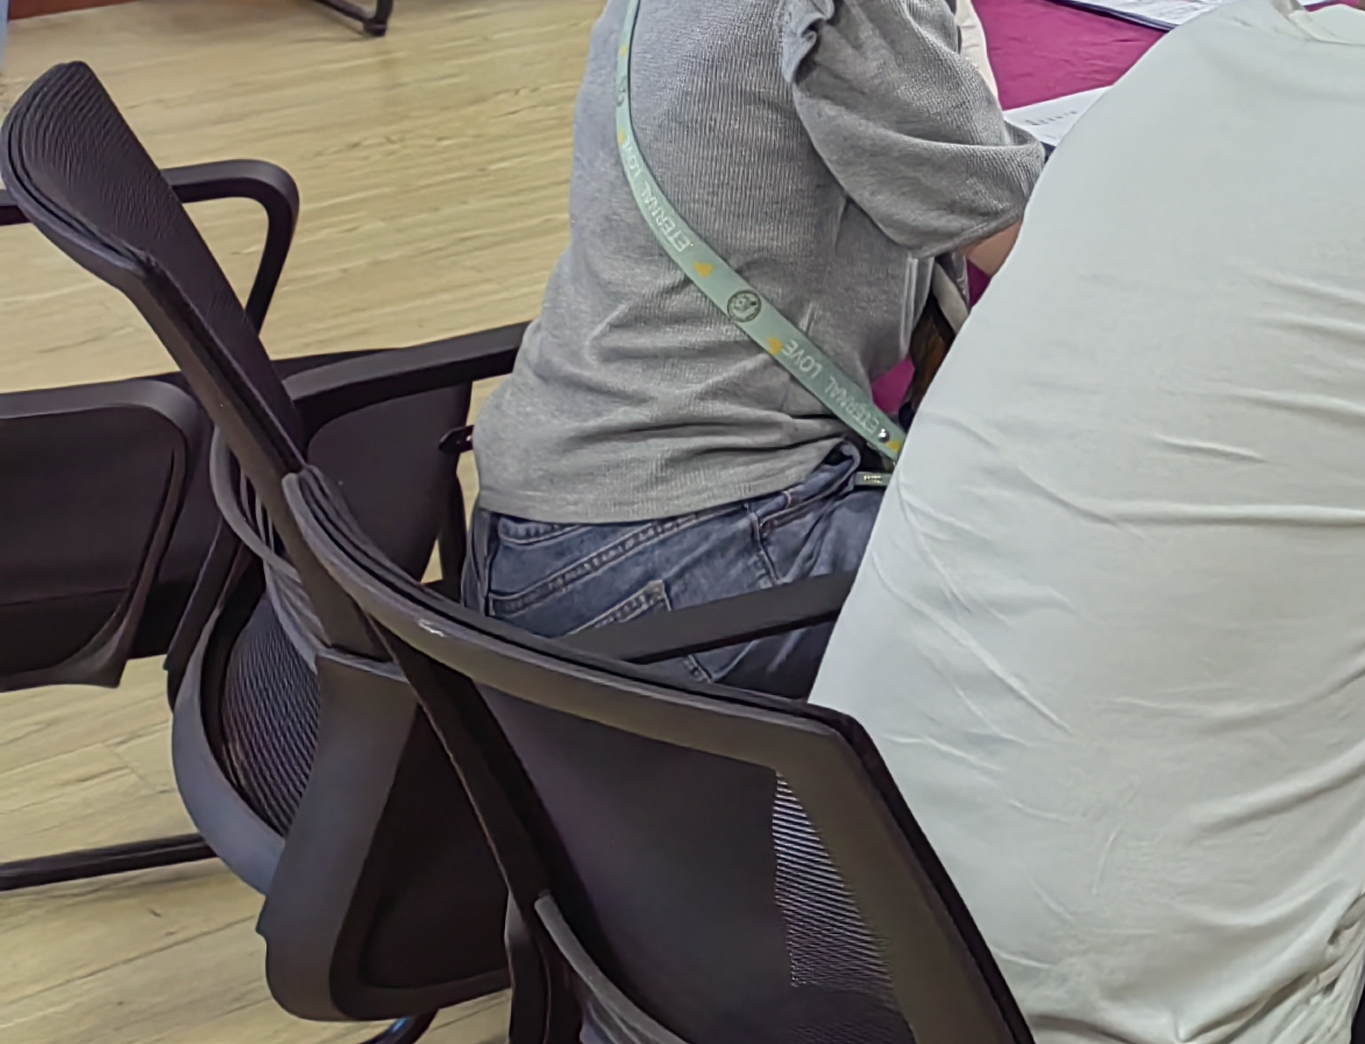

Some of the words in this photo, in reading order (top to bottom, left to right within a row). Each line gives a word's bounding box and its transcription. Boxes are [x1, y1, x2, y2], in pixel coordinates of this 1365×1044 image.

[641, 180, 690, 252] ETERNAL
[781, 339, 823, 379] LOVE
[824, 375, 880, 435] ETERNAL
